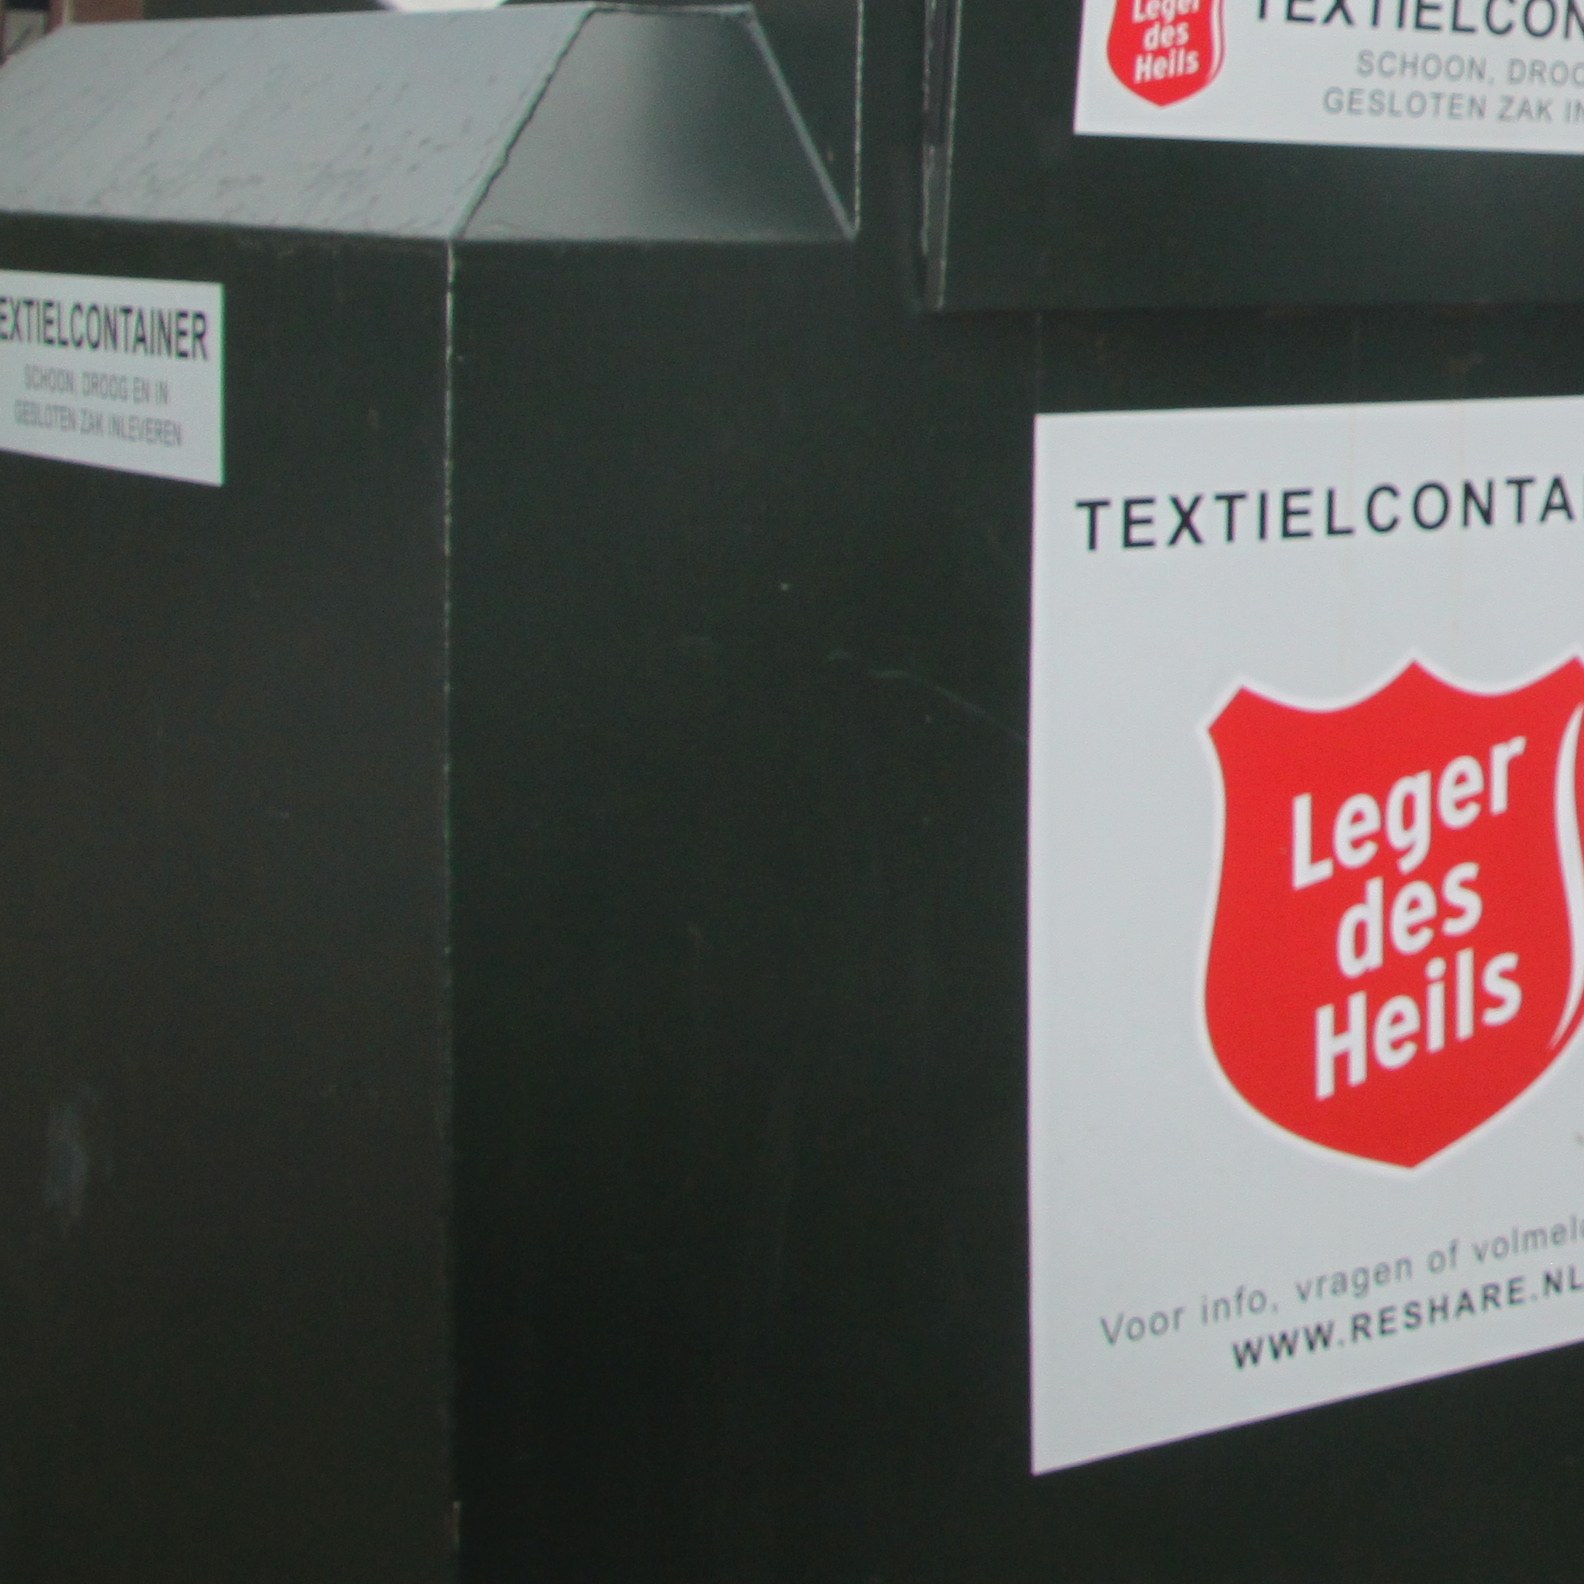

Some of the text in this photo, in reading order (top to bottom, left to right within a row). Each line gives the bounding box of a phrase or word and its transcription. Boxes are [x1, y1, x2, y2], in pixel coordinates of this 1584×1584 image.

[1133, 48, 1200, 84] Heils
[1143, 21, 1190, 50] des
[1322, 86, 1488, 120] GESLOTEN
[1498, 94, 1553, 123] ZAK
[1292, 736, 1527, 891] Leger
[1337, 862, 1483, 979] des
[1315, 947, 1522, 1101] Heils
[1100, 1307, 1184, 1347] Voor
[1201, 1285, 1280, 1325] info,
[1296, 1256, 1412, 1304] vragen
[1427, 1240, 1459, 1274] of
[1231, 1265, 1584, 1369] WWW.RESHARE.NL
